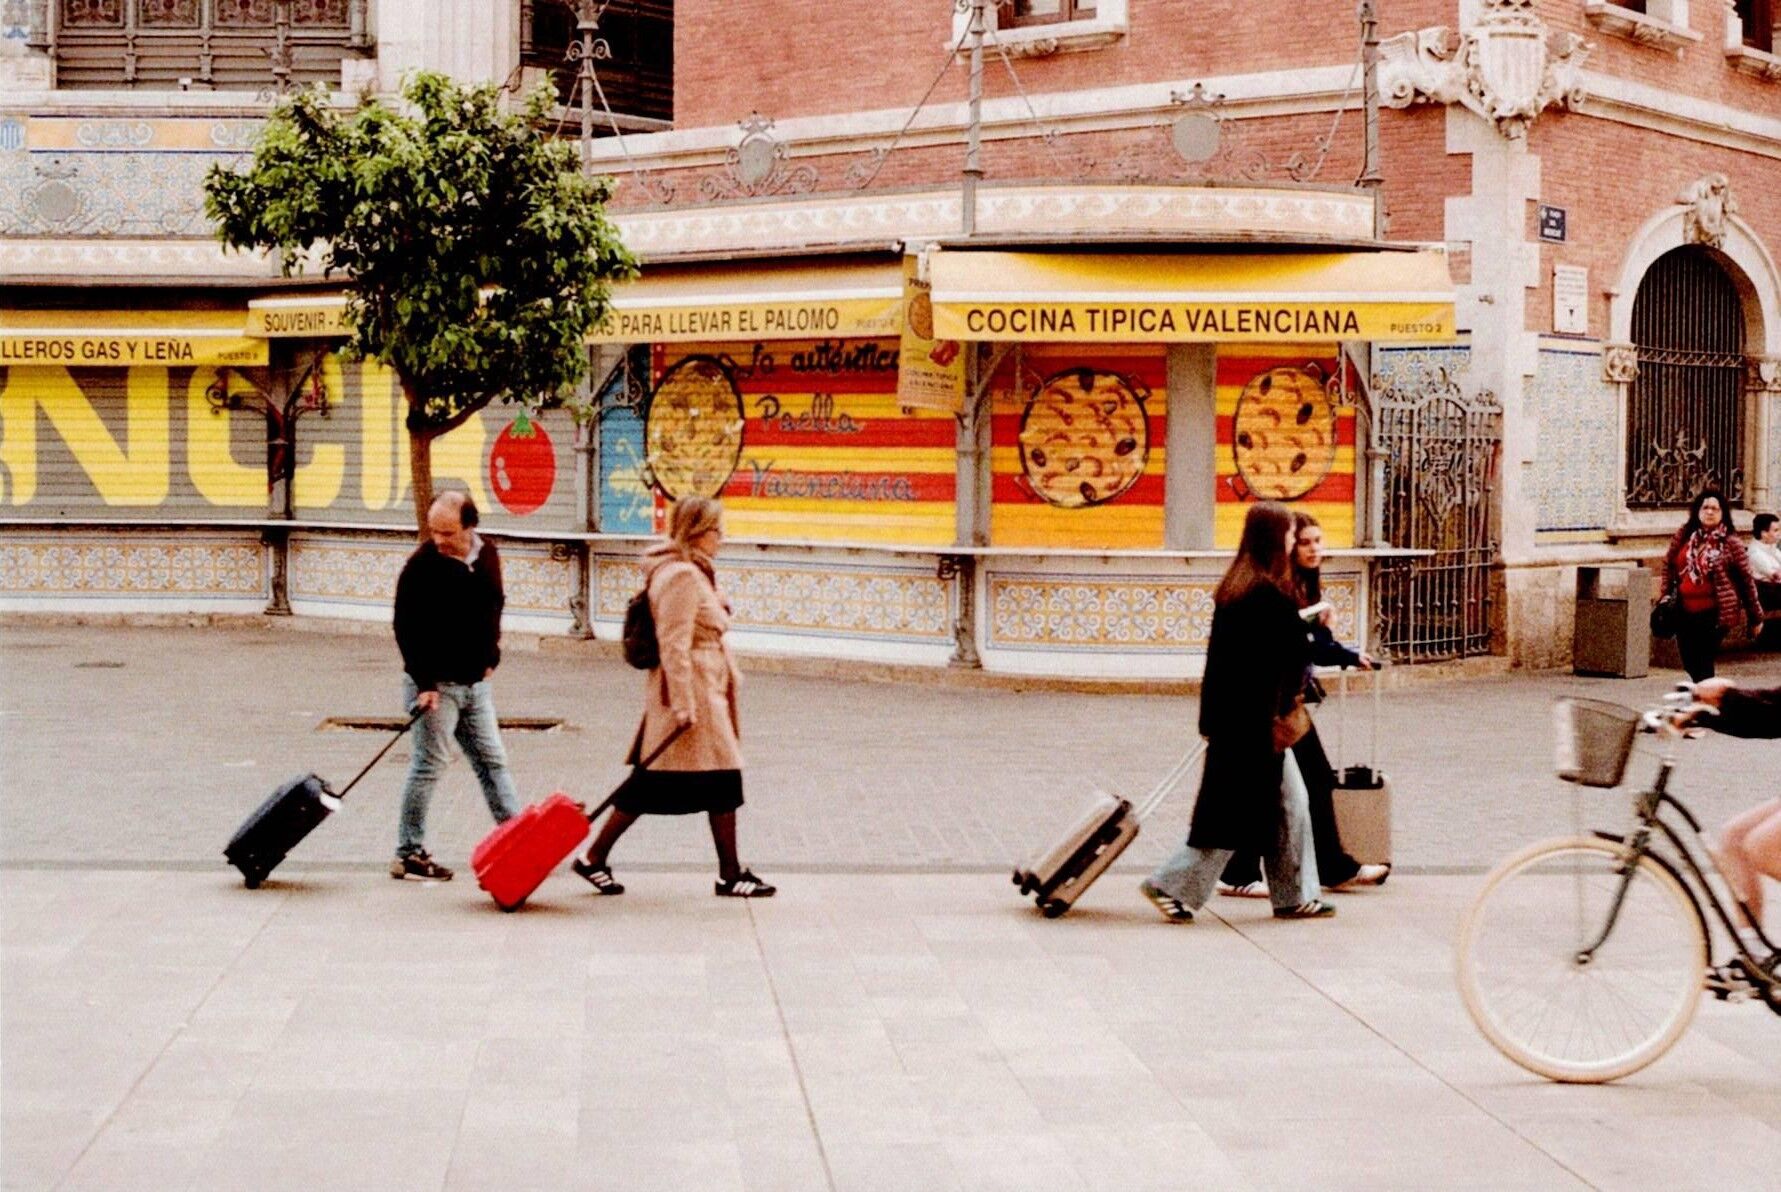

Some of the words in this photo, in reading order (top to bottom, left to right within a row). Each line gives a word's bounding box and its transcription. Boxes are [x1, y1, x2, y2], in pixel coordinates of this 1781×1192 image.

[264, 312, 325, 332] SOUVENIR
[621, 313, 663, 335] PARA
[669, 310, 732, 334] LLEVAR
[738, 310, 758, 332] EL
[765, 307, 839, 331] PALOMO
[967, 308, 1076, 333] COCINA
[1085, 309, 1176, 333] TIPICA
[1186, 309, 1360, 333] VALENCIANA
[1390, 322, 1433, 333] PUESTO
[1436, 322, 1442, 333] 2
[81, 340, 120, 359] GAS
[127, 341, 138, 359] Y
[145, 338, 194, 360] LEÑA
[755, 392, 863, 433] Paella
[0, 354, 492, 513] NCIA
